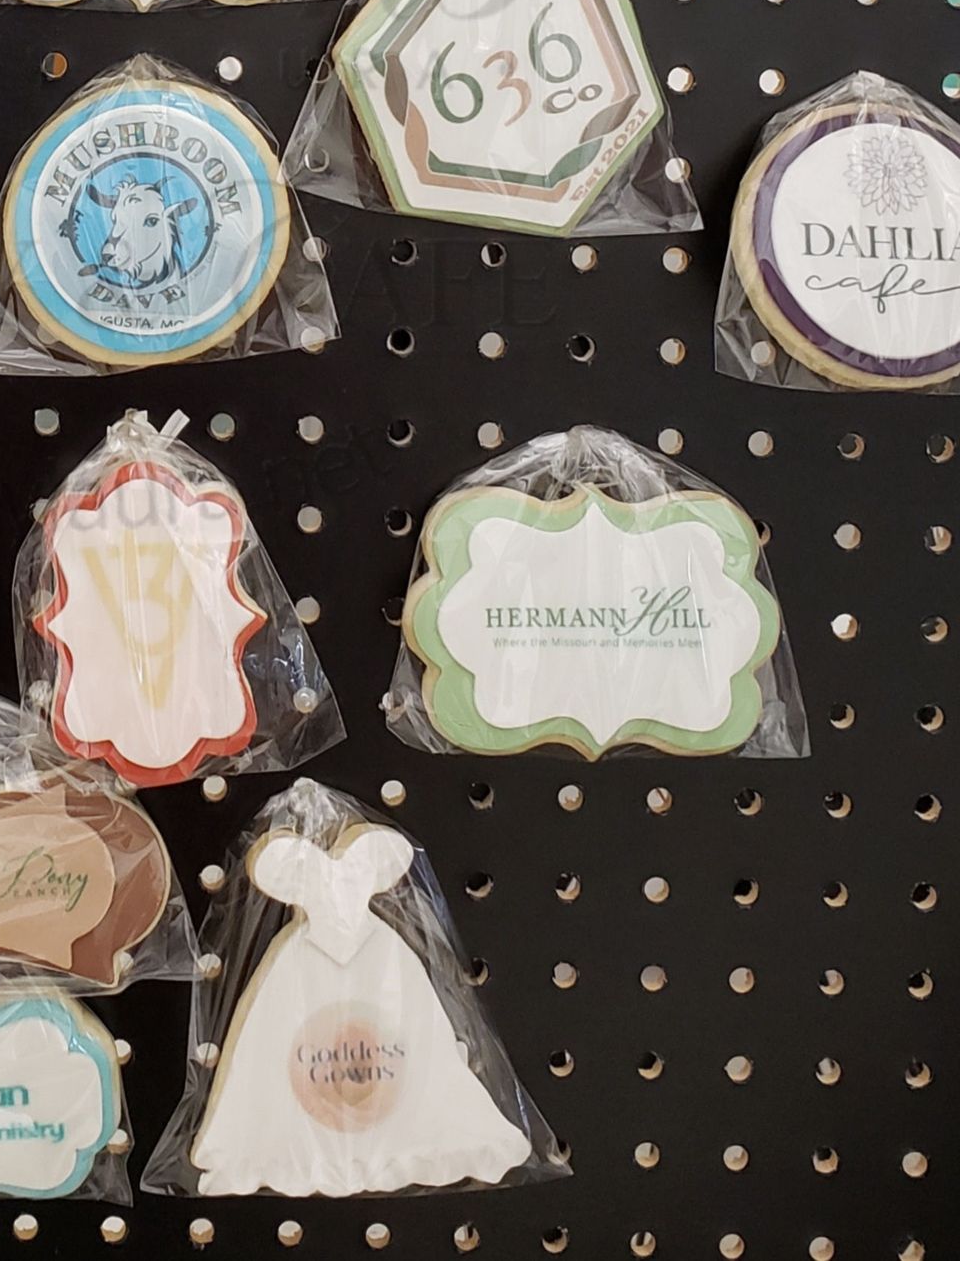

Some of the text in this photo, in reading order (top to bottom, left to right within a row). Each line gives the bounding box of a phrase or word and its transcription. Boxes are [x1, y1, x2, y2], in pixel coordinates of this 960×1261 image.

[430, 1, 583, 127] 636
[44, 121, 242, 217] MUSHROOM
[88, 282, 186, 311] DAVE
[485, 607, 628, 628] HERMANN
